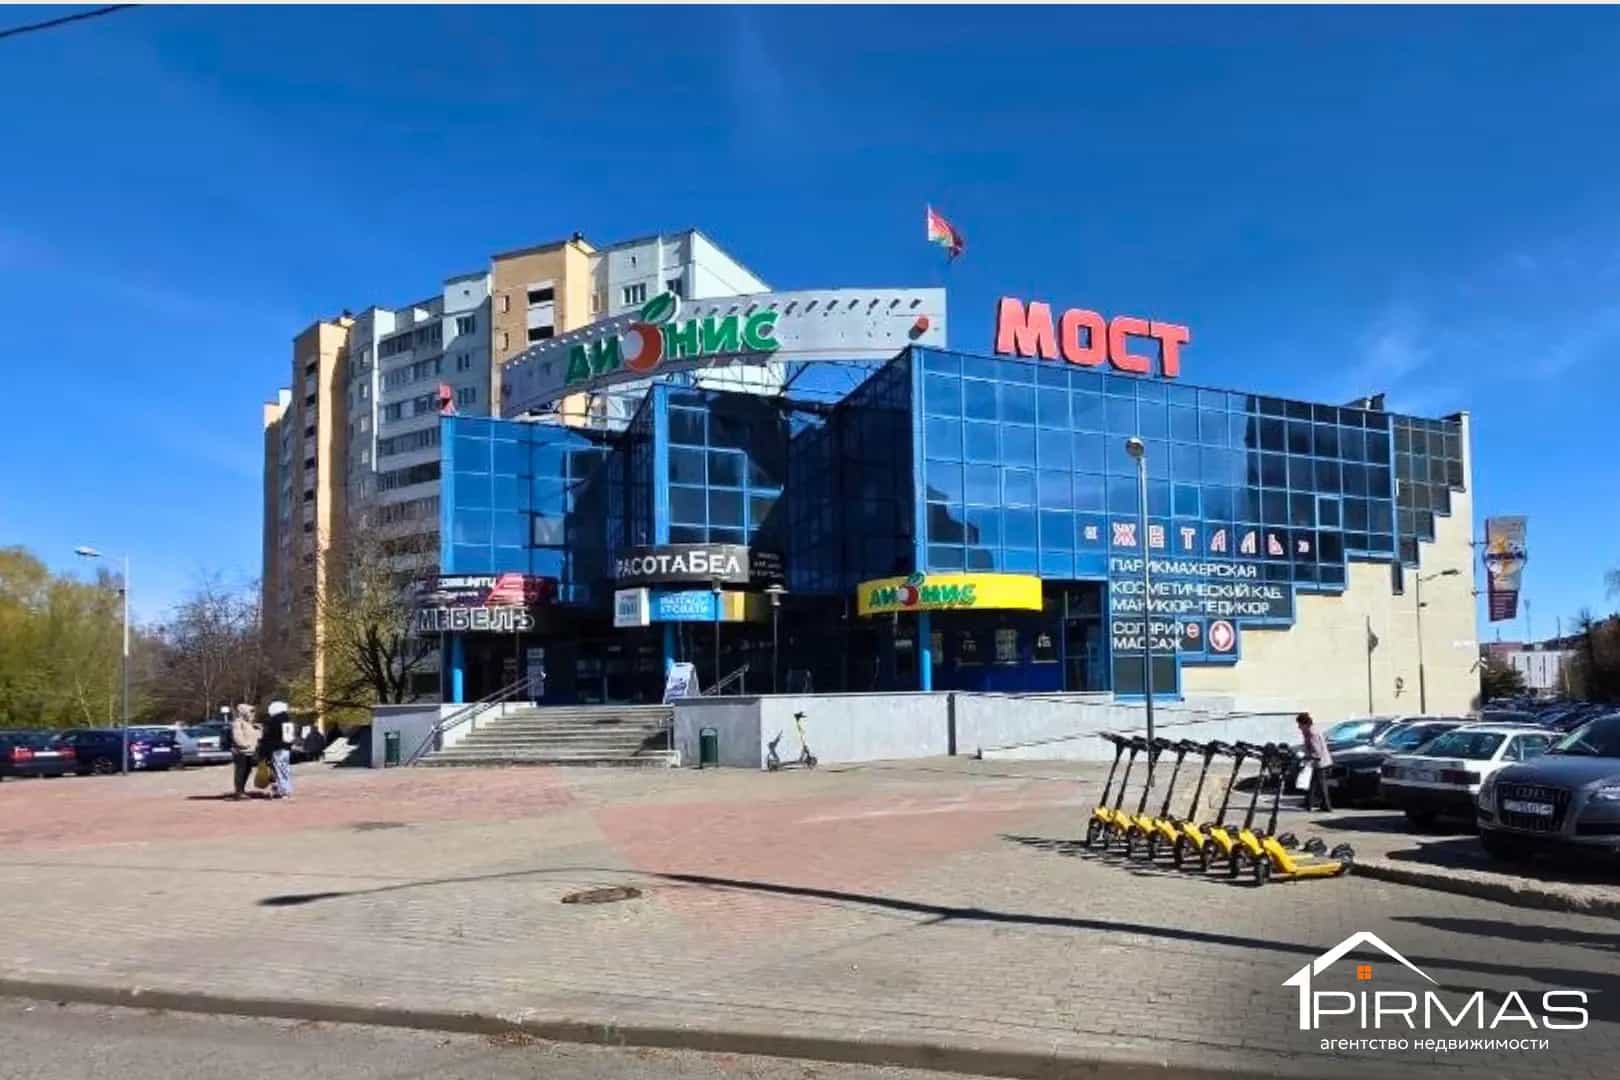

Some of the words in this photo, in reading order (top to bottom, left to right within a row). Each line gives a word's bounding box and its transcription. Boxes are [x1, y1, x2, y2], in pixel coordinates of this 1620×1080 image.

[564, 305, 781, 386] ДИОНИС
[994, 296, 1190, 378] МОСТ
[1110, 558, 1258, 578] ПАРИКМАХЕРСКАЯ
[1110, 579, 1252, 599] КОСМЕТИЧЕСКИЙ
[416, 605, 536, 632] МЕБЕЛЬ
[1112, 636, 1184, 651] МАССАЖ
